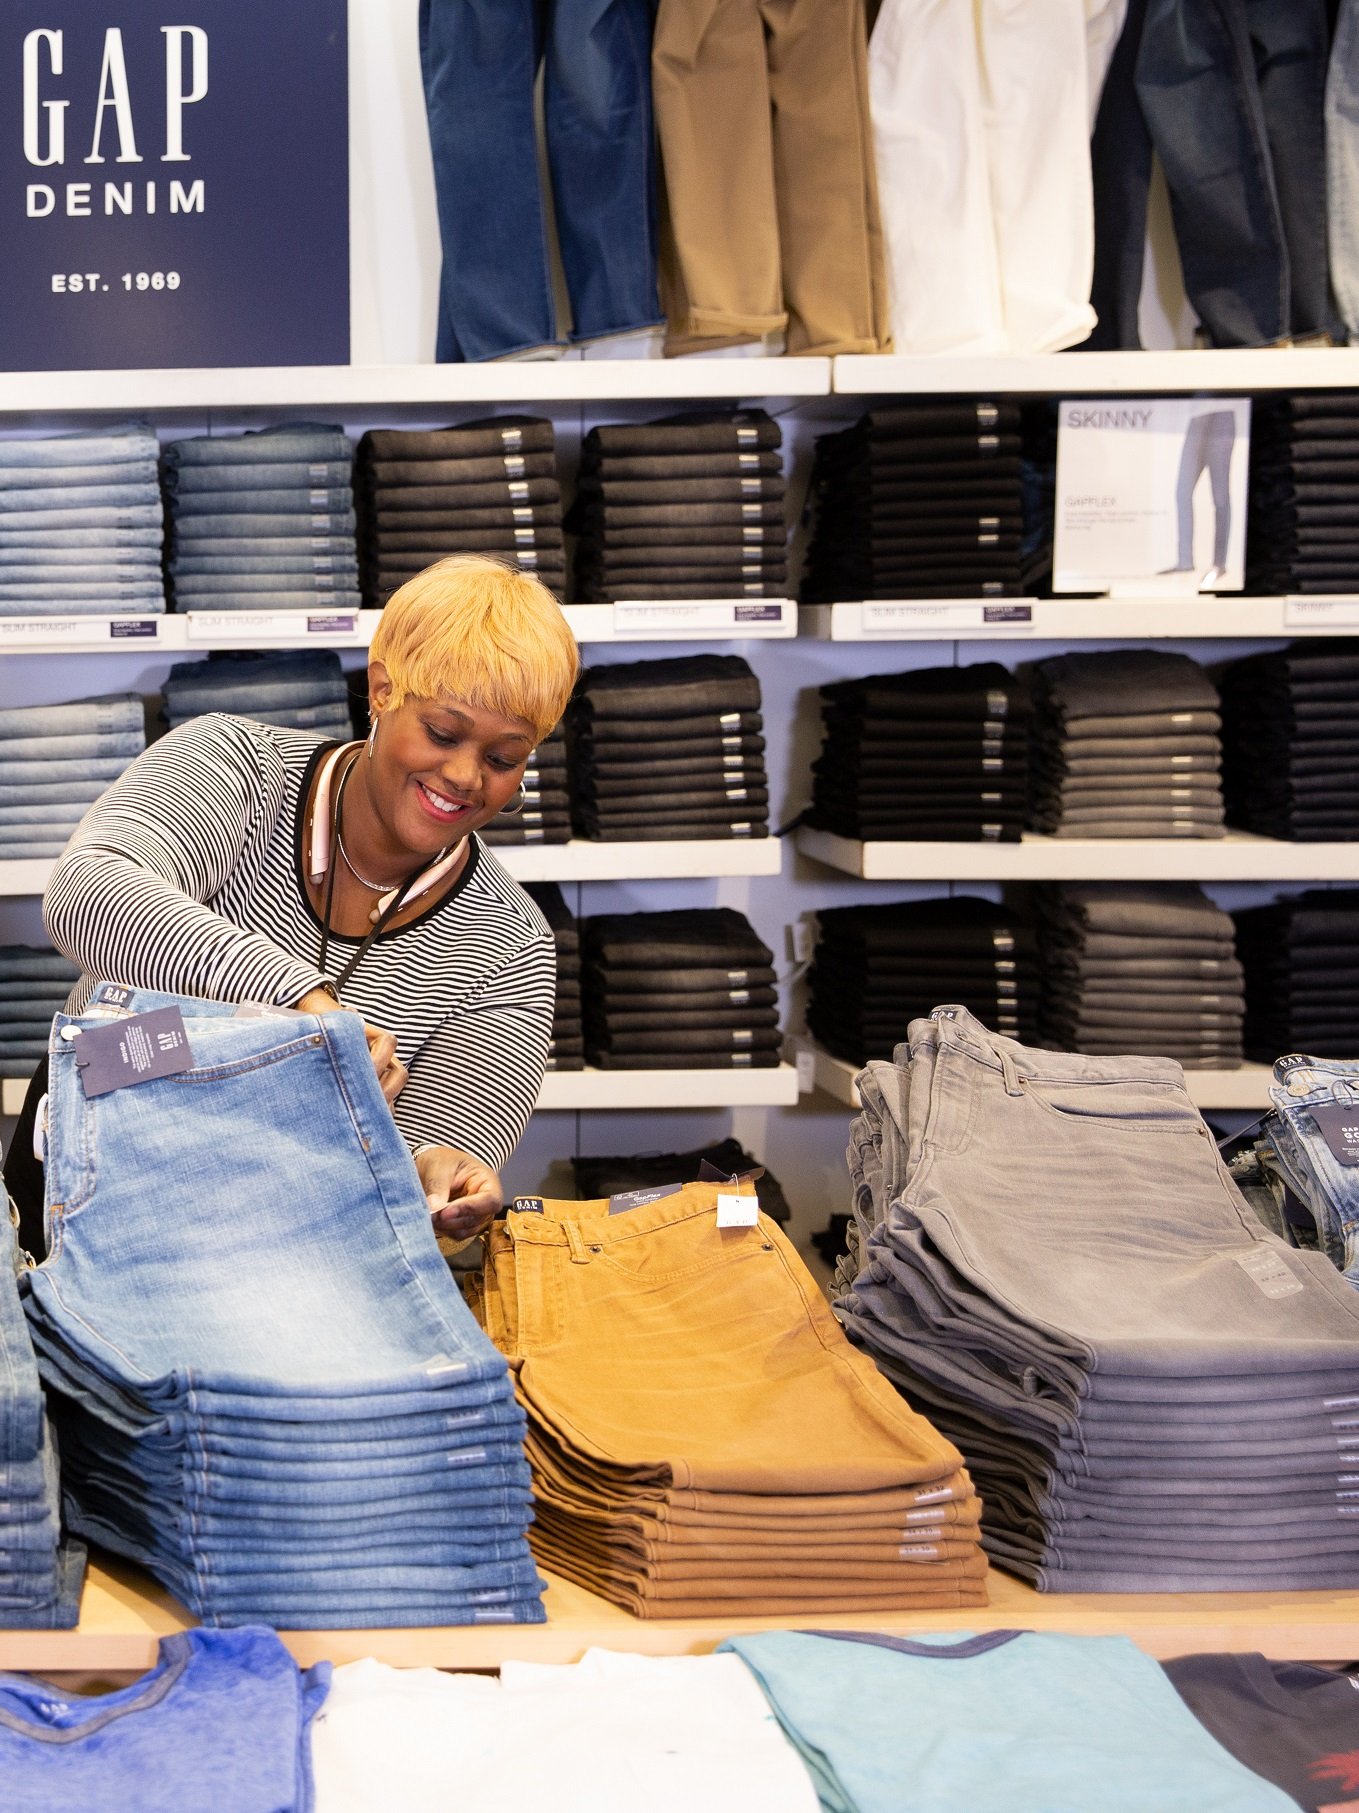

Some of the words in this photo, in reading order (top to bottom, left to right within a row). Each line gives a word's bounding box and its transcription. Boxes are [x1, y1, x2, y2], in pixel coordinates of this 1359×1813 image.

[23, 25, 209, 166] GAP
[26, 180, 205, 218] DENIM
[51, 273, 110, 293] EST.
[122, 271, 181, 291] 1969
[1067, 409, 1153, 430] SKINNY
[104, 986, 128, 1003] GAP
[120, 1041, 129, 1064] INDIGO
[157, 1033, 174, 1051] GAP
[1280, 1056, 1303, 1068] GAP
[516, 1200, 538, 1208] GAP
